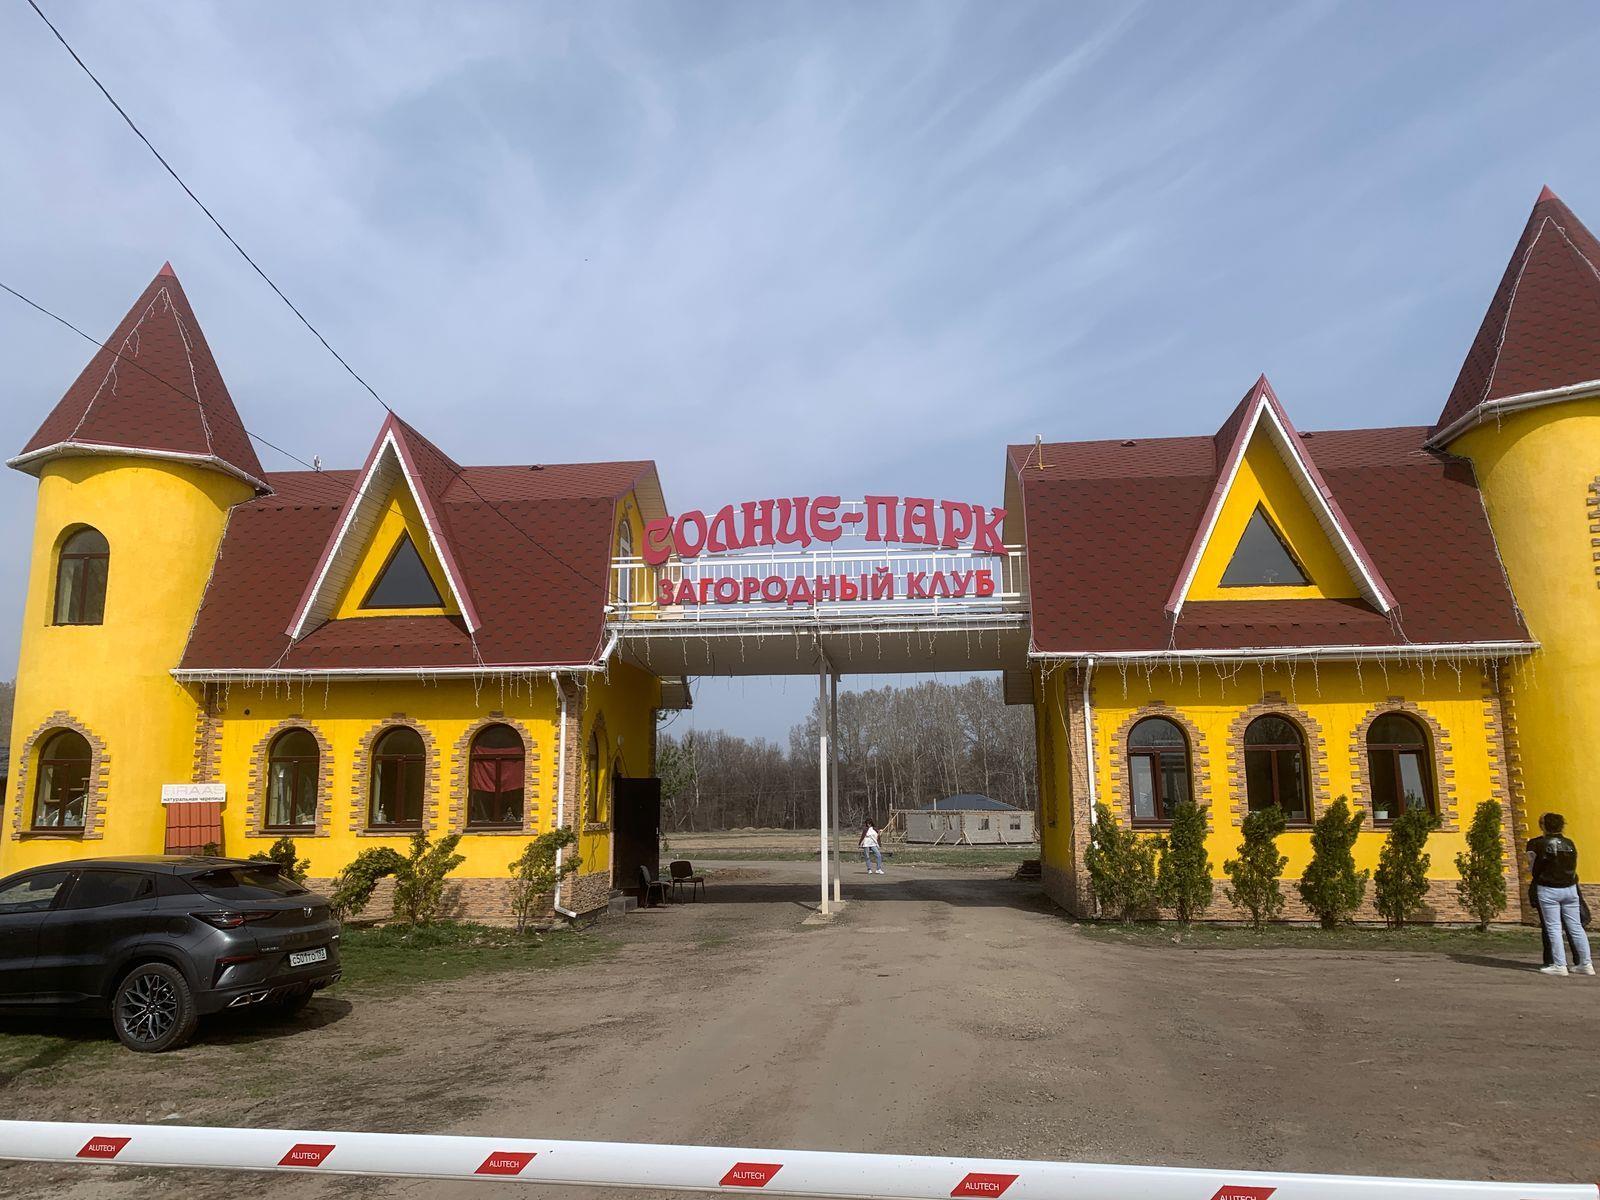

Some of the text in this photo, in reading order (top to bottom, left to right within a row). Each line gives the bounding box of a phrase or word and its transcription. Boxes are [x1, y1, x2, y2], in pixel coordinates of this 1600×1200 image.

[642, 495, 1008, 566] СОЛНЦЕ-ПАРК
[658, 566, 995, 606] ЗАГОРОДНЫЙ КЛУБ
[88, 1144, 116, 1152] ALUTECH
[291, 1151, 320, 1160] ALUTECH
[489, 1159, 520, 1168] ALUTECH
[732, 1171, 765, 1180] ALUTECH
[965, 1181, 1000, 1191] ALUTECH
